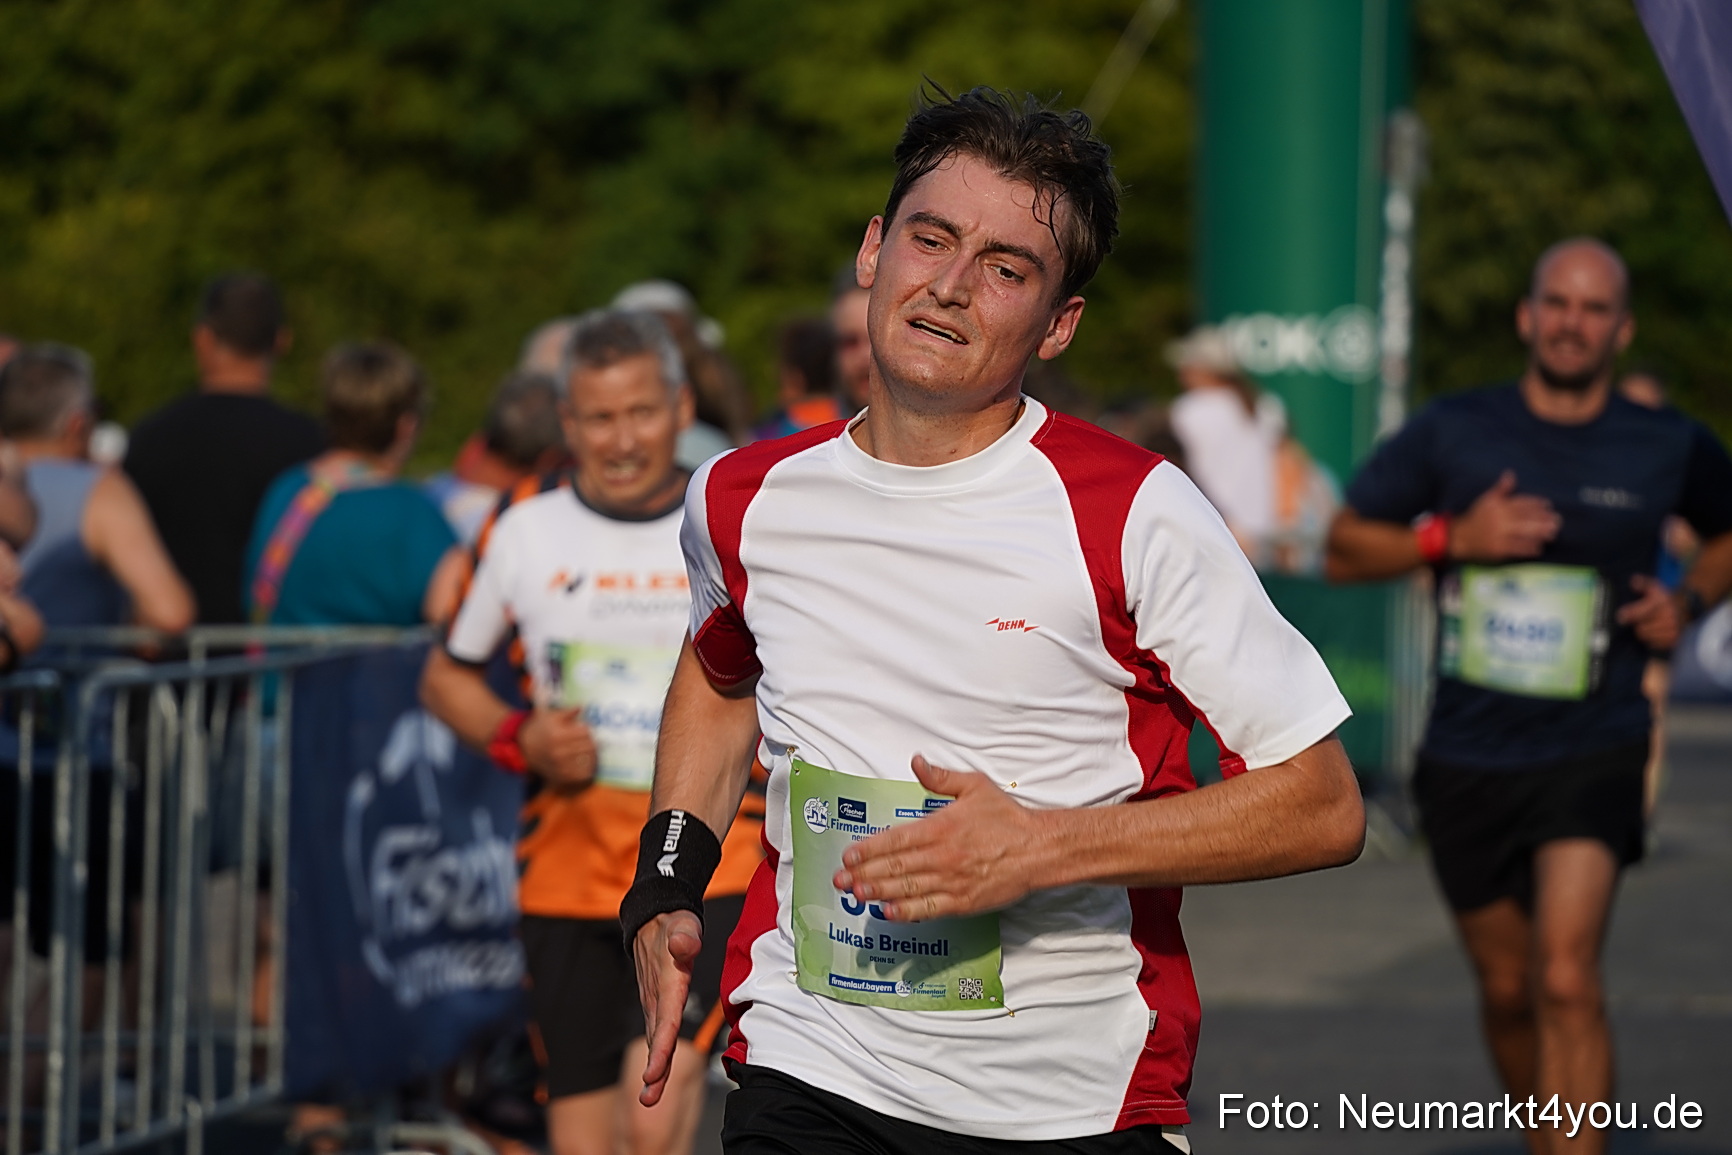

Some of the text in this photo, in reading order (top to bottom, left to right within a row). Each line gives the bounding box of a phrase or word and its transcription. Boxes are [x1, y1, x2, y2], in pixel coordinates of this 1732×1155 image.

[997, 619, 1026, 631] DEHN
[844, 807, 865, 816] Fischer
[829, 922, 949, 956] Lukas Breindl
[870, 955, 887, 963] DEHN
[831, 976, 892, 992] firmenlauf.bayern
